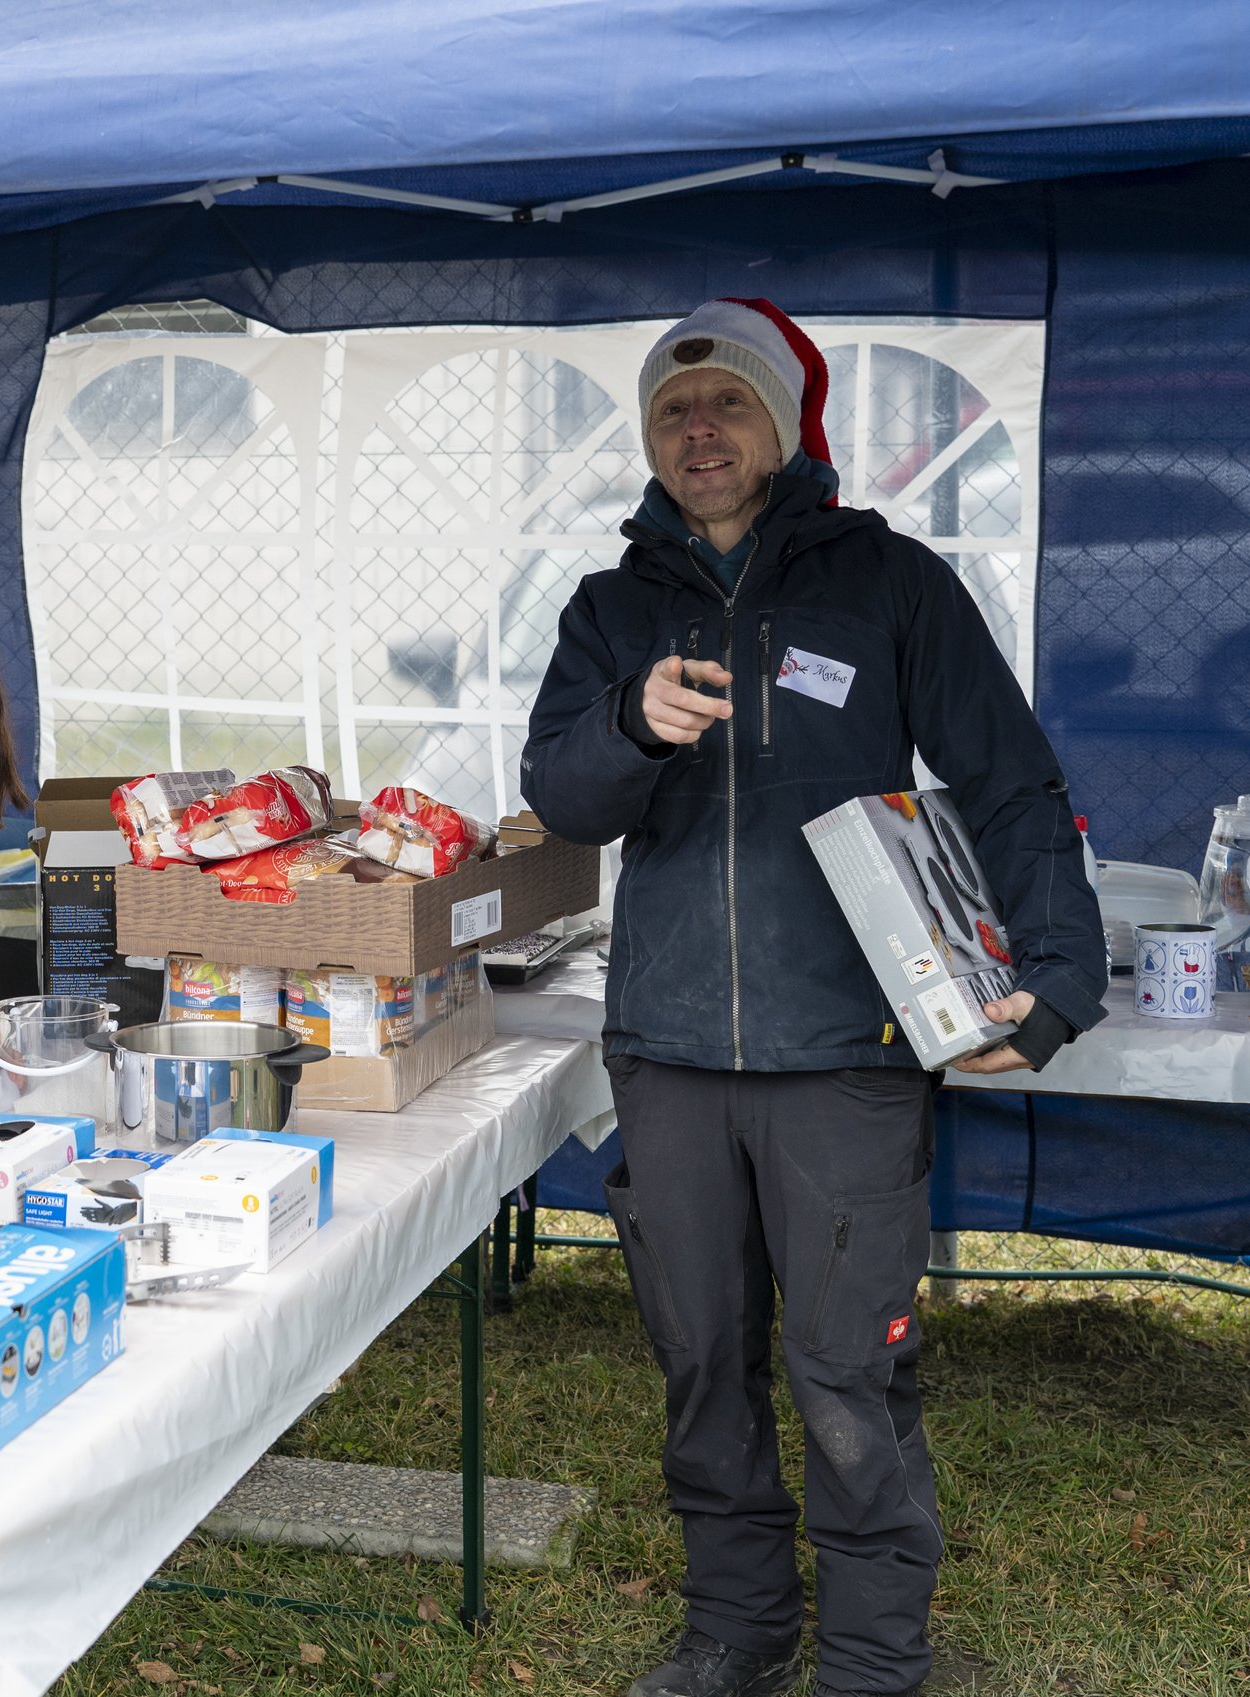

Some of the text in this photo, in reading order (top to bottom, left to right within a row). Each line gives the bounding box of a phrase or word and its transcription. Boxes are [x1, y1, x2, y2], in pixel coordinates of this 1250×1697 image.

[854, 818, 891, 885] Einzelkochplatte
[49, 874, 112, 882] HOT DO
[93, 884, 100, 892] 3
[185, 984, 210, 995] hilcona
[183, 1010, 215, 1021] Bündner
[38, 1209, 53, 1217] LIGHT
